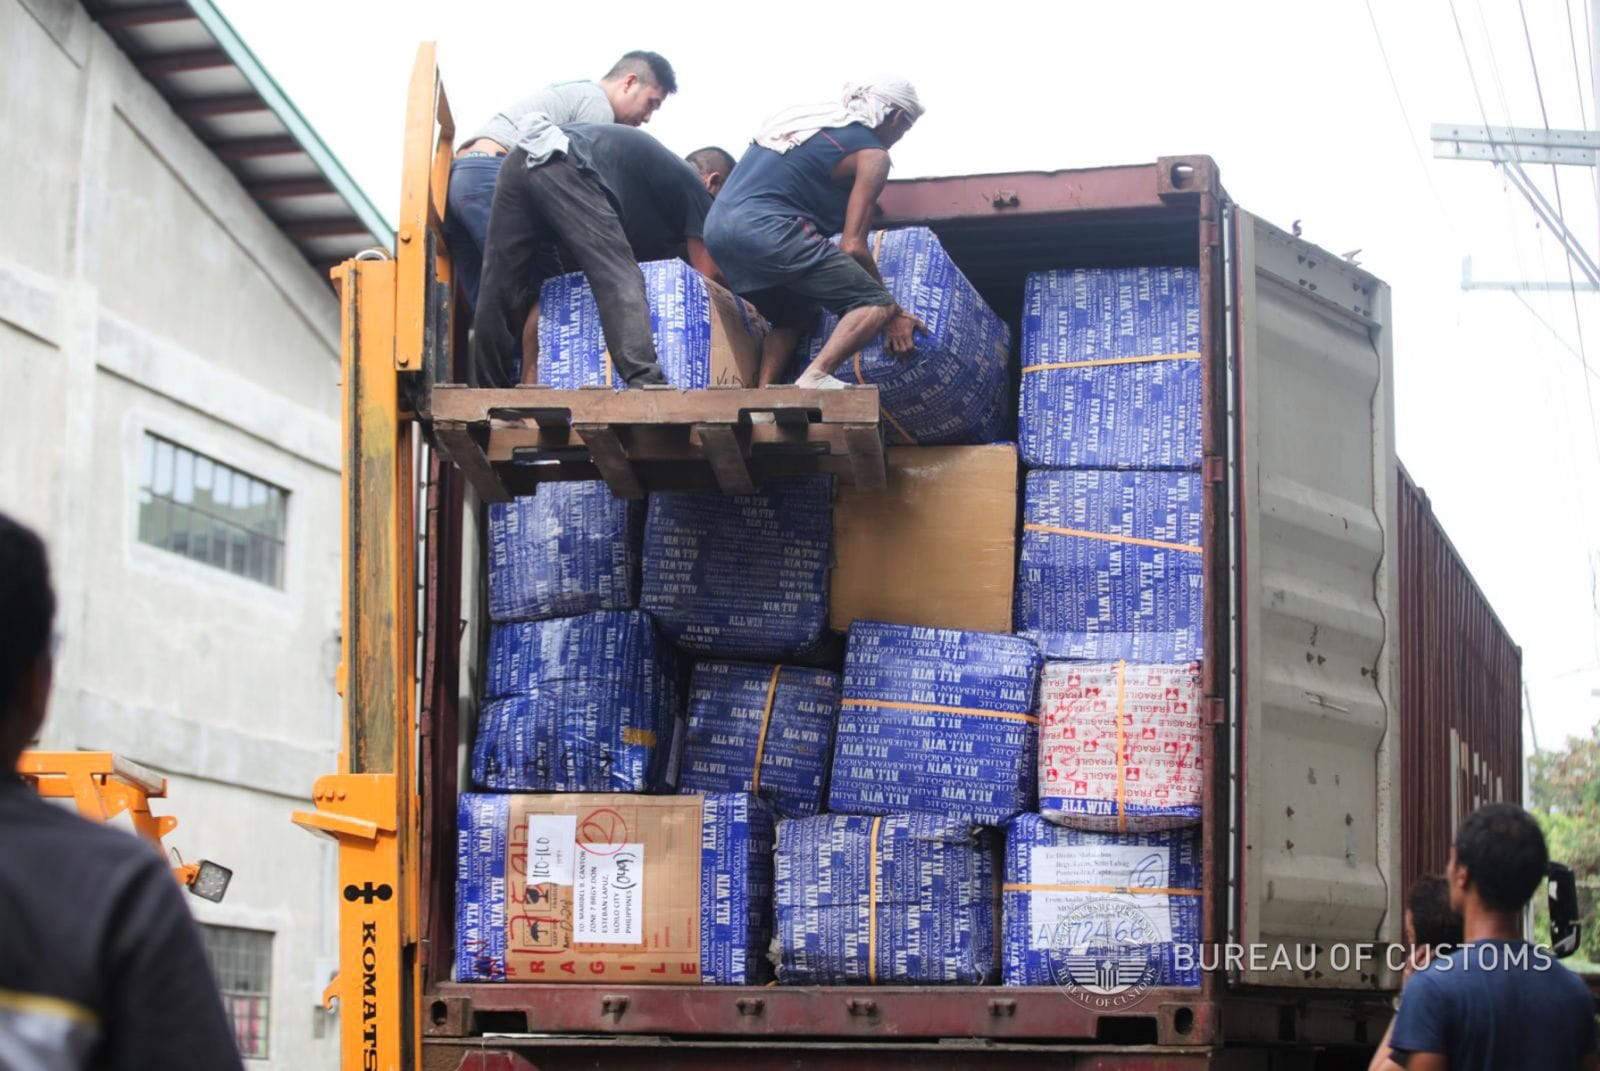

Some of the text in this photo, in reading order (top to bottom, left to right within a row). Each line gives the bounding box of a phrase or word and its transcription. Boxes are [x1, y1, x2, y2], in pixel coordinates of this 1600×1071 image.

[570, 287, 581, 335] ALL WIN
[675, 278, 685, 329] ALL WIN
[1120, 285, 1134, 336] ALL WIN
[559, 325, 569, 374] ALL WIN
[1063, 385, 1074, 440] ALL WIN
[1088, 398, 1100, 452] ALL WIN
[1074, 472, 1087, 522] ALL WIN
[1166, 488, 1176, 539] ALL WIN
[493, 521, 507, 565] ALL WIN
[1110, 551, 1121, 576] WIN
[1153, 553, 1164, 578] WIN
[1097, 571, 1110, 621] ALL WIN
[1140, 561, 1153, 615] ALL WIN
[729, 616, 763, 627] ALL WIN
[911, 627, 936, 639] WIN
[916, 648, 941, 657] WIN
[712, 665, 729, 673] WIN
[911, 669, 936, 680] WIN
[937, 671, 961, 683] ALL
[940, 684, 996, 696] BALIKBAYAN
[1000, 689, 1025, 701] WIN
[731, 707, 748, 718] ALL
[1158, 720, 1196, 728] FRAGILE
[711, 735, 745, 747] ALL WIN
[783, 728, 819, 742] ALL WIN
[865, 736, 972, 753] ALL WIN BALIKBAYAN
[841, 745, 888, 758] ALL WIN
[954, 756, 1011, 767] BALIKBAYAN
[1155, 759, 1192, 768] FRAGILE
[692, 761, 726, 774] ALL WIN
[869, 761, 978, 776] ALL WIN BALIKBAYAN
[883, 785, 938, 796] BALIKBAYAN
[941, 787, 966, 800] WIN
[967, 790, 993, 802] ALL
[481, 803, 493, 826] ALL
[703, 800, 717, 822] WIN
[734, 799, 747, 822] ALL
[1062, 800, 1112, 814] ALL WIN
[480, 828, 492, 852] WIN
[703, 825, 716, 850] ALL
[718, 815, 726, 870] BALIKBAYAN
[459, 830, 468, 879] ALL WIN
[778, 855, 791, 905] ALL WIN
[818, 843, 831, 894] ALL WIN
[717, 874, 730, 898] WIN
[793, 867, 801, 921] BALIKBAYAN
[921, 861, 932, 911] ALL WIN
[491, 876, 504, 927] ALL WIN
[717, 900, 730, 925] ALL
[467, 902, 478, 952] ALL WIN
[732, 889, 740, 944] BALIKBAYAN
[908, 905, 920, 930] WIN
[702, 916, 710, 971] BALIKBAYAN
[793, 924, 805, 949] WIN
[908, 931, 920, 955] ALL
[732, 948, 745, 973] WIN
